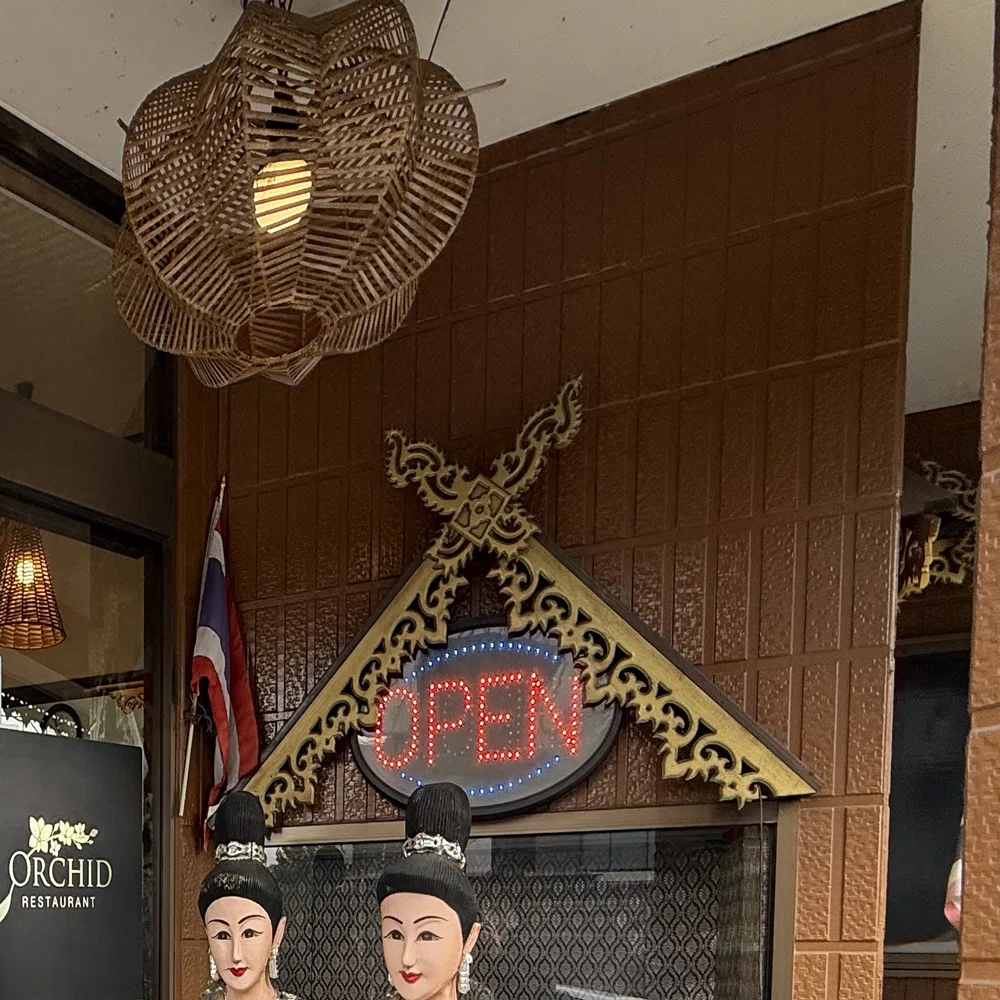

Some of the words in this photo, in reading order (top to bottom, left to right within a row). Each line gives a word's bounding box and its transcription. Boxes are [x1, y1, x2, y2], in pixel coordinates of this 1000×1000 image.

[374, 668, 583, 770] OPEN
[9, 850, 113, 888] ORCHID
[21, 895, 96, 909] RESTAURANT
